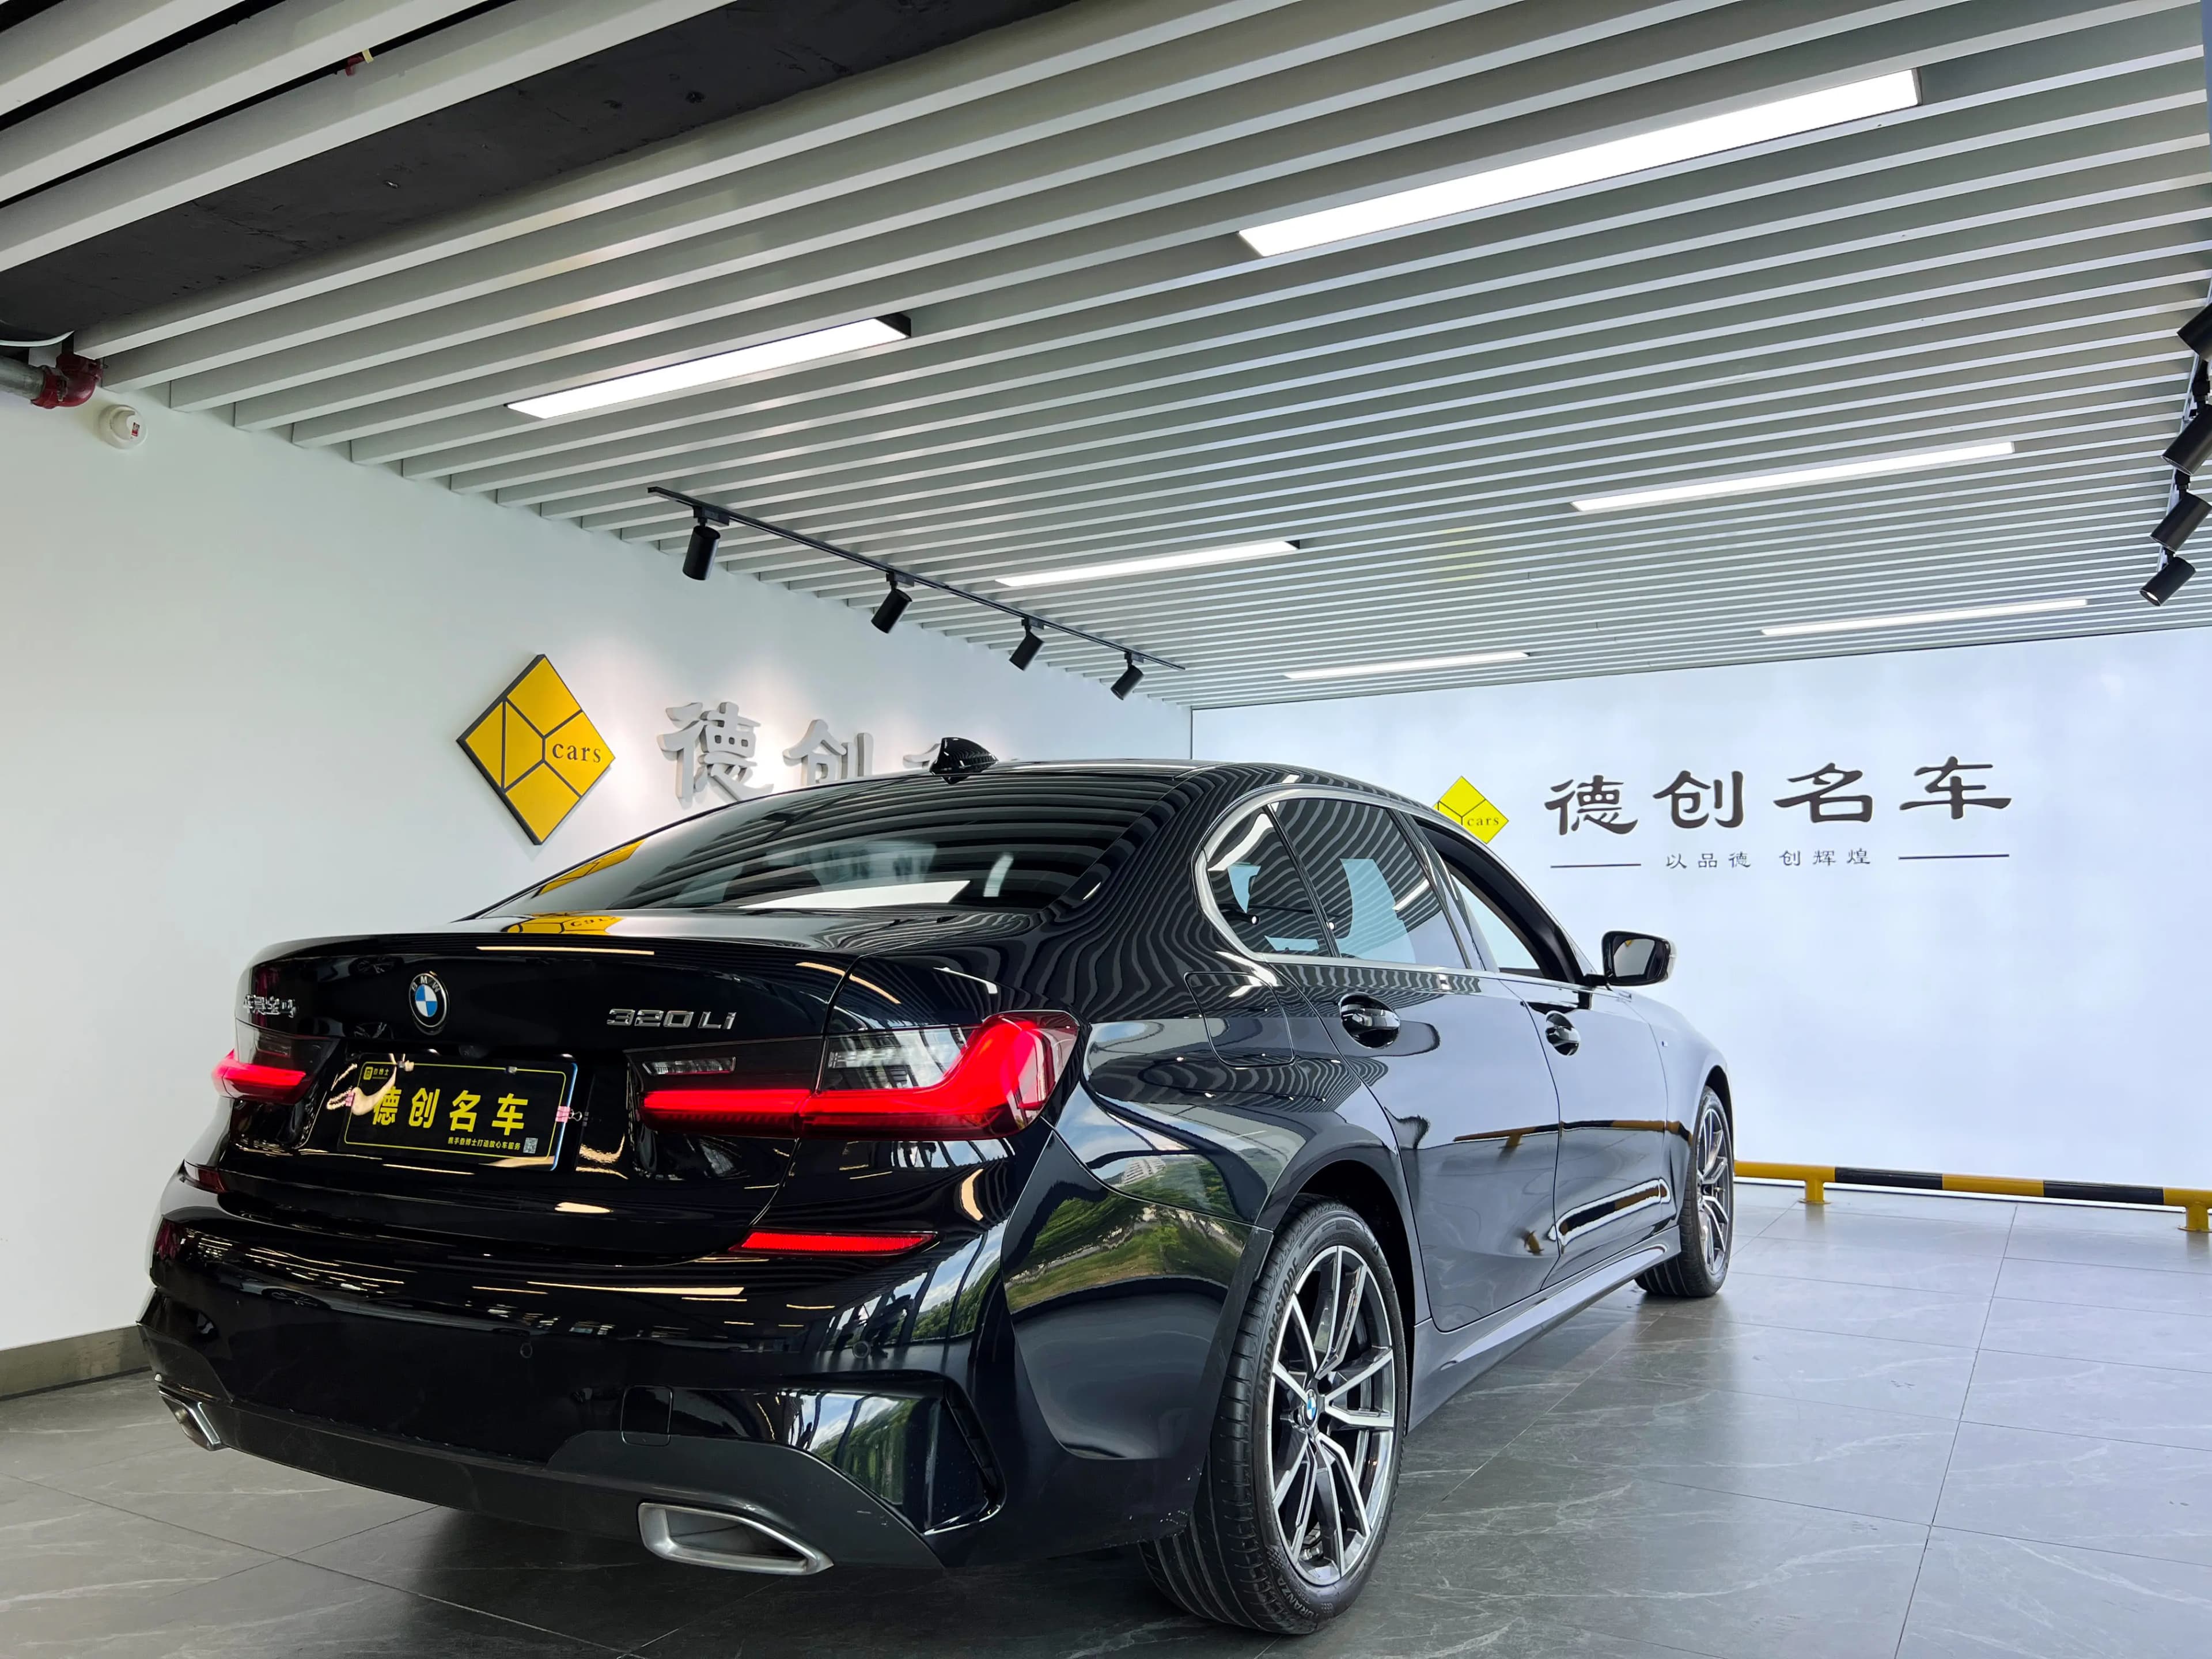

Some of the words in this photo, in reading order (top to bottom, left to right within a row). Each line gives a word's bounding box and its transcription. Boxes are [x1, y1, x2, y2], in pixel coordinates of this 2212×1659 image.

[552, 743, 601, 763] cars
[657, 702, 942, 808] 德创
[1544, 756, 2012, 835] 德创名车
[1467, 817, 1499, 827] cars
[1665, 850, 1752, 869] 以品德
[1778, 847, 1871, 867] 创辉煌
[411, 975, 441, 993] BMW
[372, 1086, 529, 1136] 德创名车
[1278, 1575, 1319, 1618] URANZA
